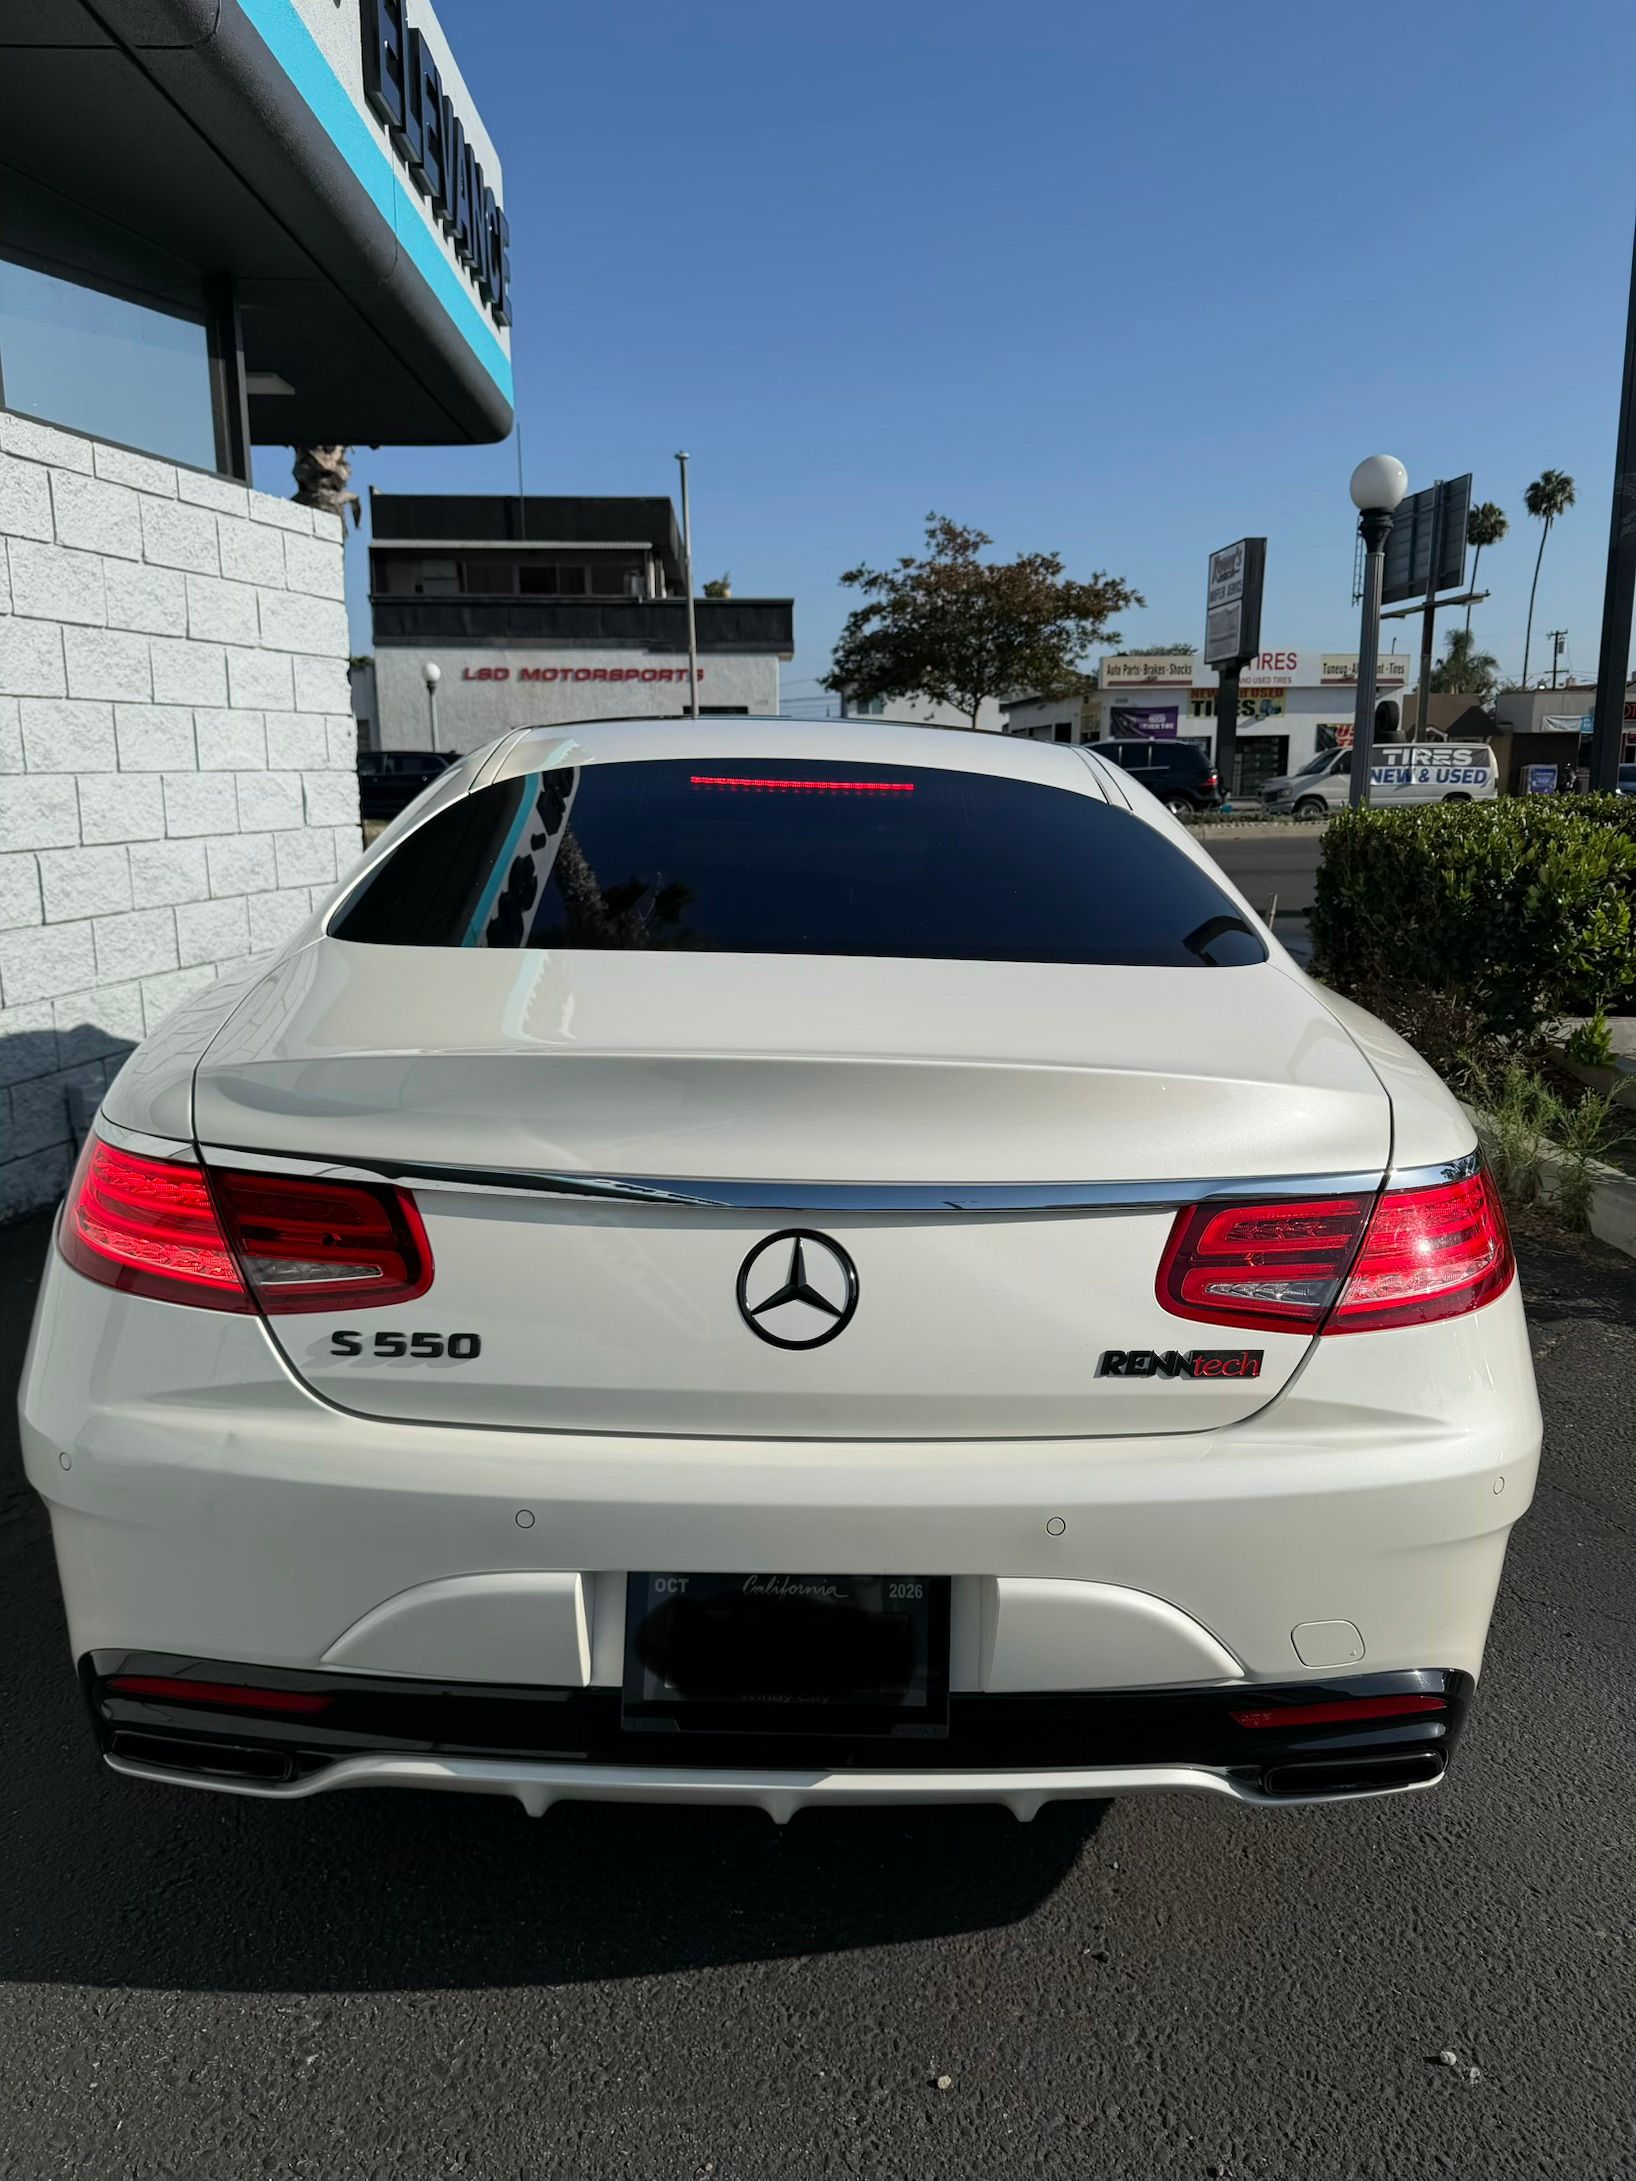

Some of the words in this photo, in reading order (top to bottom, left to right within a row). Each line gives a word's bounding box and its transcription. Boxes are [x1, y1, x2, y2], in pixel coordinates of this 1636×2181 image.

[463, 667, 509, 682] LSD
[520, 668, 704, 683] MOTORSPORTS
[1107, 664, 1121, 676] Auto
[1123, 664, 1140, 676] Parts
[1144, 663, 1165, 676] Brakes
[1169, 663, 1192, 675] Shocks
[1390, 662, 1404, 674] Tires
[1253, 676, 1271, 684] USED
[1273, 676, 1292, 684] TIRES
[1251, 687, 1283, 698] USED
[1191, 700, 1256, 717] TIS
[1382, 748, 1473, 766] TIRES
[1370, 768, 1413, 784] NEW
[1419, 768, 1430, 783] &
[1435, 768, 1488, 785] USED
[330, 1330, 363, 1356] S
[373, 1331, 482, 1359] 550
[655, 1578, 690, 1593] OCT
[742, 1574, 849, 1602] California
[889, 1583, 924, 1600] 2026
